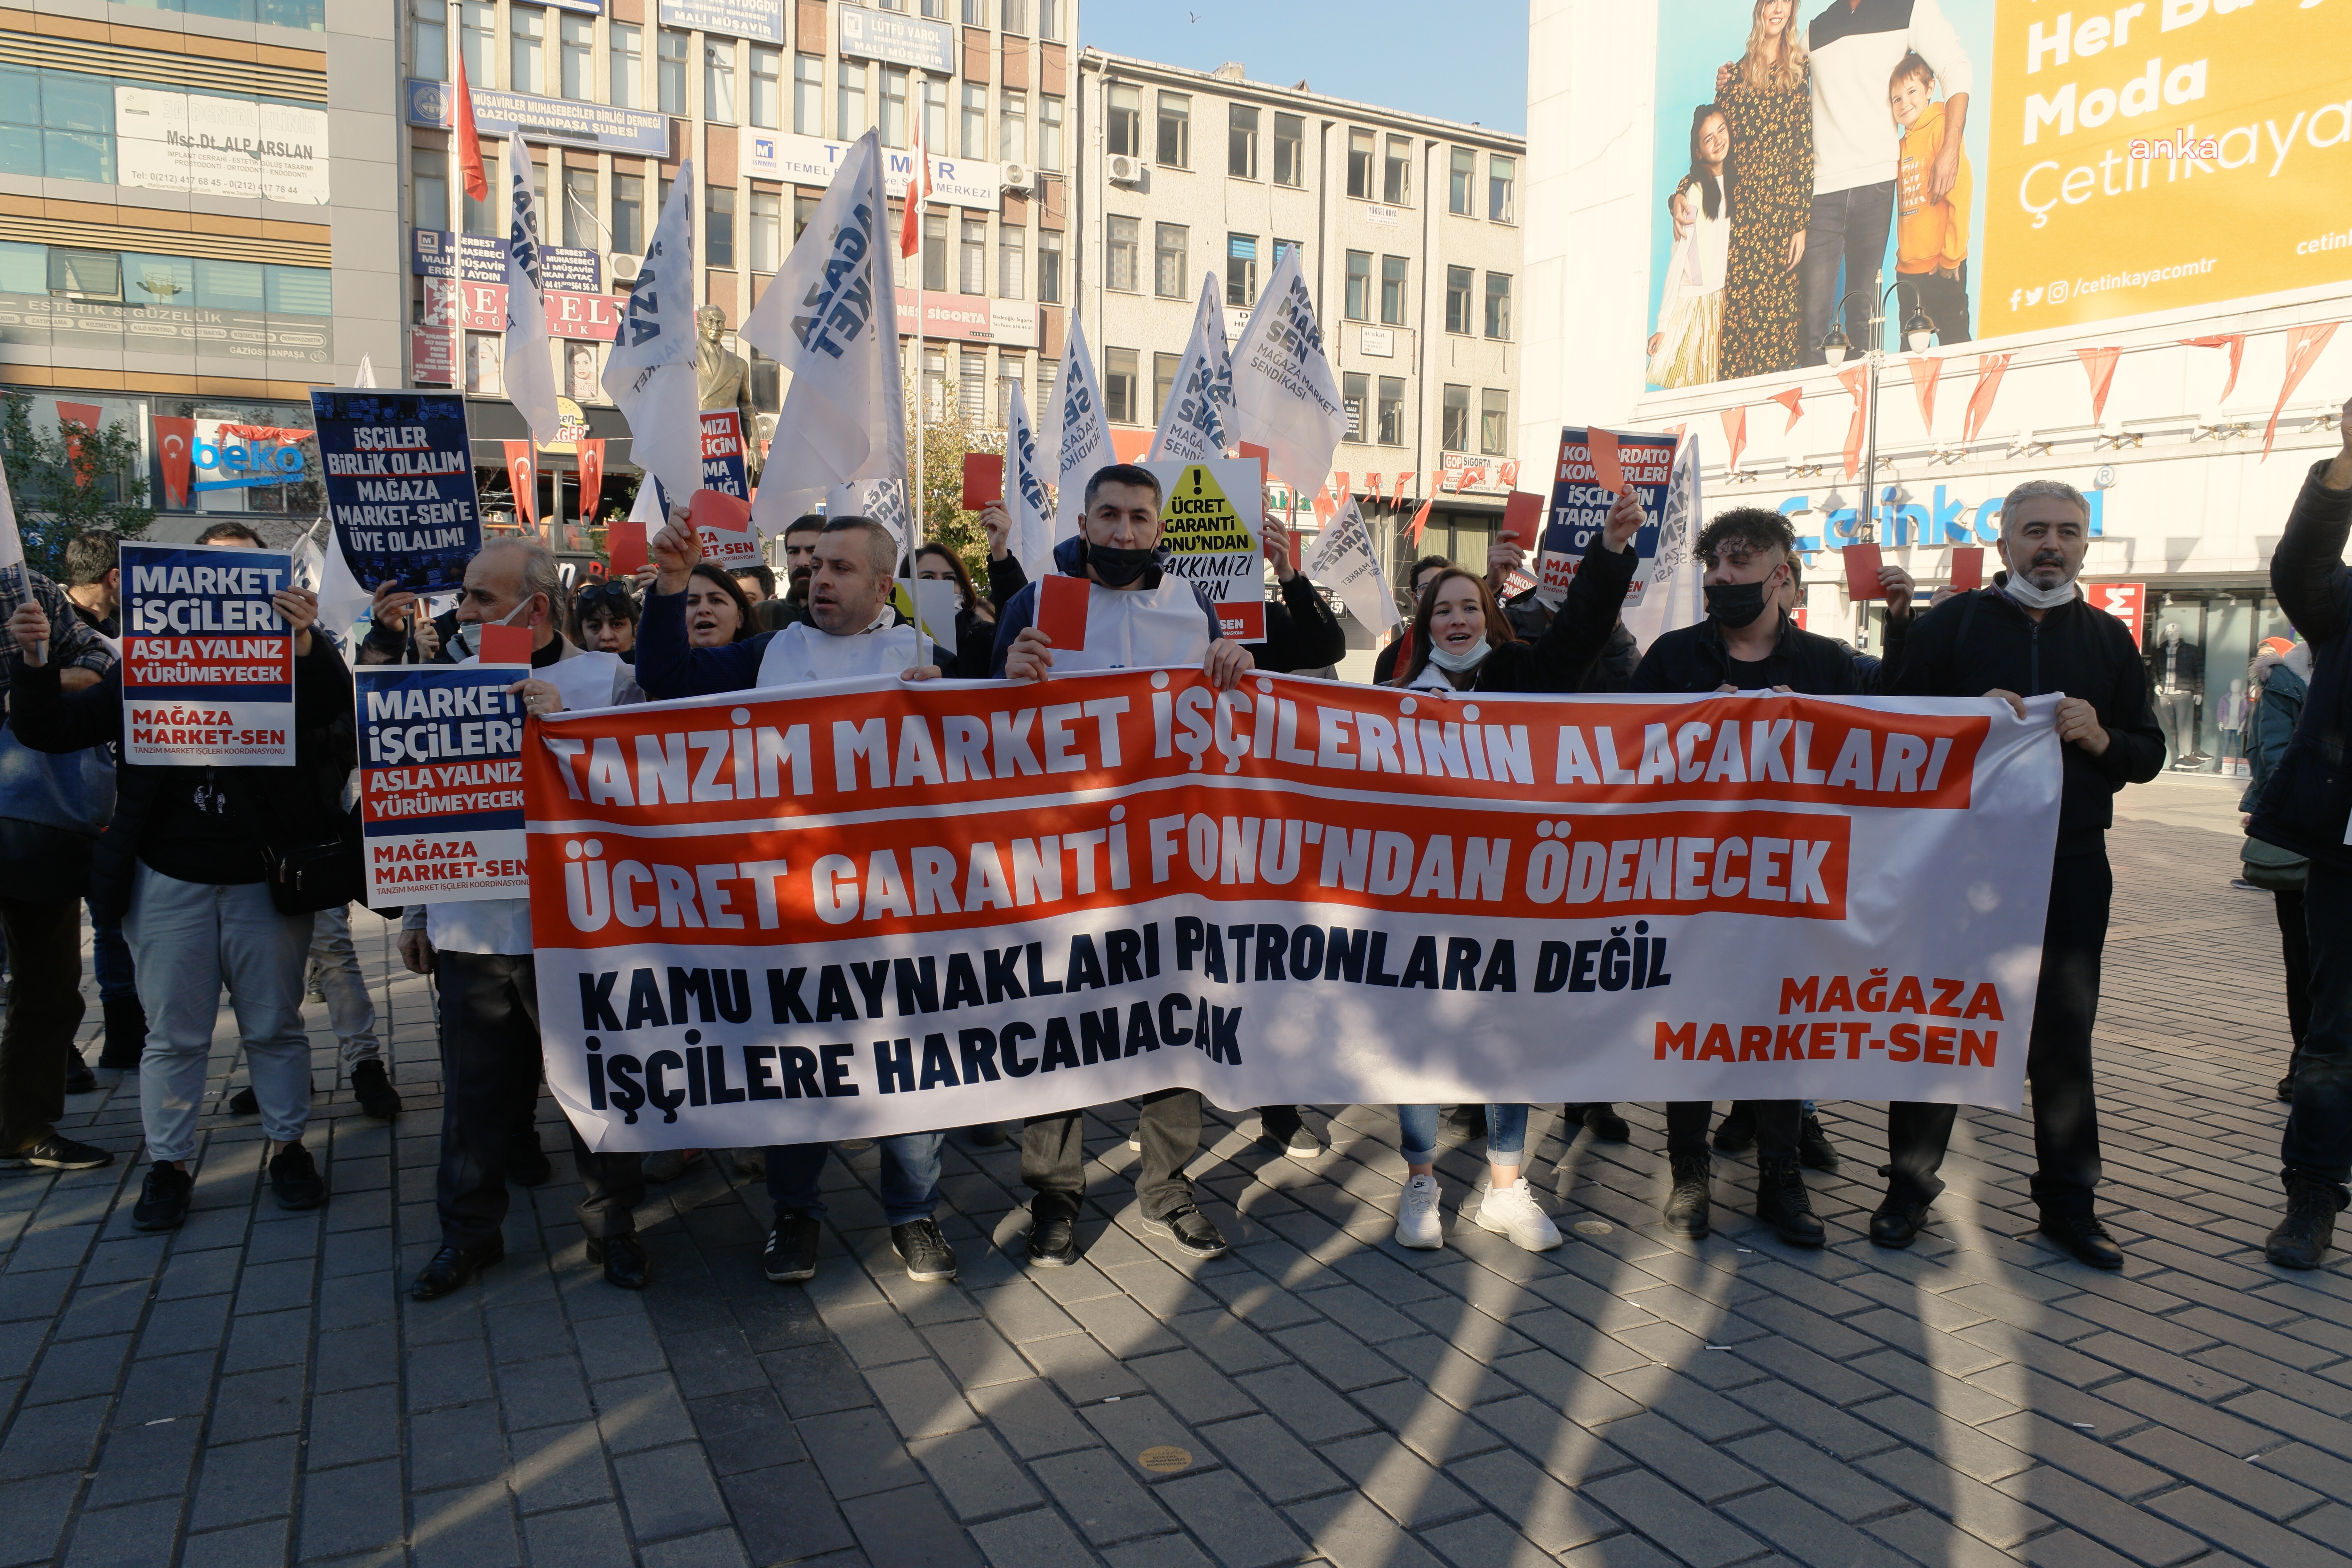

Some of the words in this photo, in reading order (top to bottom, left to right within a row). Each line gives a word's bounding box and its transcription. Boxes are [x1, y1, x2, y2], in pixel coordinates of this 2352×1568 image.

[674, 10, 707, 24] MALİ
[711, 16, 771, 36] MÜŞAVİR
[871, 18, 904, 36] LÜTFÜ
[907, 25, 941, 43] VAROL
[2028, 2, 2145, 75] Her
[854, 41, 883, 54] MALİ
[888, 47, 943, 65] MÜŞAVİR
[473, 93, 526, 112] MÜŞAVİRLER
[528, 101, 595, 121] MUHASEBECİLER
[596, 110, 625, 125] BİRLİĞİ
[627, 113, 661, 130] DERNEĞİ
[2023, 58, 2208, 146] Moda
[191, 103, 257, 128] DENTAL
[261, 109, 316, 134] KLİNİK
[476, 107, 589, 132] GAZİOSMANPAŞA
[592, 123, 638, 138] ŞUBESİ
[225, 136, 251, 152] ALP
[257, 139, 313, 160] ARSLAN
[167, 150, 196, 160] İMPLANT
[198, 153, 227, 163] CERRAHİ
[261, 159, 282, 169] GÜLÜŞ
[284, 162, 313, 171] TASARIMI
[175, 159, 222, 170] PROSTODONTİ
[227, 164, 265, 174] ORTODONTİ
[270, 169, 307, 178] ENDODONTİ
[785, 162, 830, 176] TEMEL
[2019, 100, 2352, 229] Çetinkaya
[132, 171, 147, 180] Tel:
[151, 172, 177, 183] 0(212)
[180, 175, 195, 185] 417
[199, 177, 209, 185] 68
[211, 178, 221, 187] 45
[229, 180, 255, 191] 0(212)
[259, 183, 272, 192] 417
[275, 184, 285, 193] 78
[288, 185, 298, 195] 44
[937, 183, 991, 199] MERKEZİ
[1369, 204, 1385, 216] YÜKSEL
[1386, 208, 1397, 218] KAYA
[422, 254, 450, 266] MALİ
[546, 255, 595, 266] MUHASEBECİ
[555, 248, 587, 257] SERBEST
[467, 270, 501, 282] AYDIN
[552, 264, 594, 274] MÜŞAVİR
[566, 273, 593, 282] AYTAÇ
[113, 307, 127, 317] &
[133, 307, 222, 323] GÜZELLİK
[927, 306, 987, 325] SİGORTA
[229, 346, 305, 359] GAZİOSMANPAŞA
[1266, 320, 1308, 365] SEN
[1251, 356, 1306, 400] SENDİKASI
[1257, 343, 1301, 380] MAĞAZA
[1302, 376, 1338, 416] MARKET
[354, 426, 429, 451] İŞÇİLER
[706, 437, 737, 456] İÇİN
[192, 437, 304, 472] beko
[327, 453, 389, 474] BİRLİK
[392, 451, 465, 474] OLALIM
[1446, 455, 1462, 468] GOP
[1463, 457, 1491, 468] SİGORTA
[357, 478, 440, 501] MAĞAZA
[1172, 496, 1225, 515] ÜCRET
[1164, 515, 1235, 533] GARANTİ
[350, 528, 385, 552] ÜYE
[388, 527, 465, 551] OLALIM!
[132, 566, 282, 595] MARKET
[132, 597, 282, 635] İŞÇİLERİ
[131, 640, 195, 660] ASLA
[198, 640, 283, 659] YALNIZ
[131, 662, 283, 682] YÜRÜMEYECEK
[367, 684, 518, 721] MARKET
[132, 705, 234, 726] MAĞAZA
[133, 728, 285, 746] MARKET-SEN
[369, 717, 522, 764] İŞÇİLERİ
[542, 707, 813, 807] TANZİM
[832, 695, 1130, 793] MARKET
[1150, 671, 1535, 785] İŞÇİLERİNİN
[1555, 718, 1953, 793] ALACAKLARI
[196, 747, 223, 756] İŞÇİLERİ
[370, 768, 435, 793] ASLA
[436, 761, 522, 787] YALNIZ
[370, 789, 524, 817] YÜRÜMEYECEK
[373, 838, 478, 863] MAĞAZA
[375, 859, 529, 884] MARKET-SEN
[564, 838, 787, 933] ÜCRET
[812, 804, 1131, 924] GARANTİ
[1149, 812, 1511, 902] FONU'NDAN
[1525, 820, 1831, 904] ÖDENECEK
[376, 886, 406, 895] TANZİM
[407, 883, 438, 893] MARKET
[440, 881, 469, 891] İŞÇİLERİ
[579, 966, 752, 1032] KAMU
[766, 922, 1160, 1024] KAYNAKLARI
[1175, 915, 1516, 993] PATRONLARA
[1534, 920, 1671, 993] DEĞİL
[1779, 967, 2004, 1022] MAĞAZA
[1654, 1021, 1998, 1068] MARKET-SEN
[585, 1028, 859, 1125] İŞÇİLERE
[873, 992, 1243, 1094] HARCANACAK
